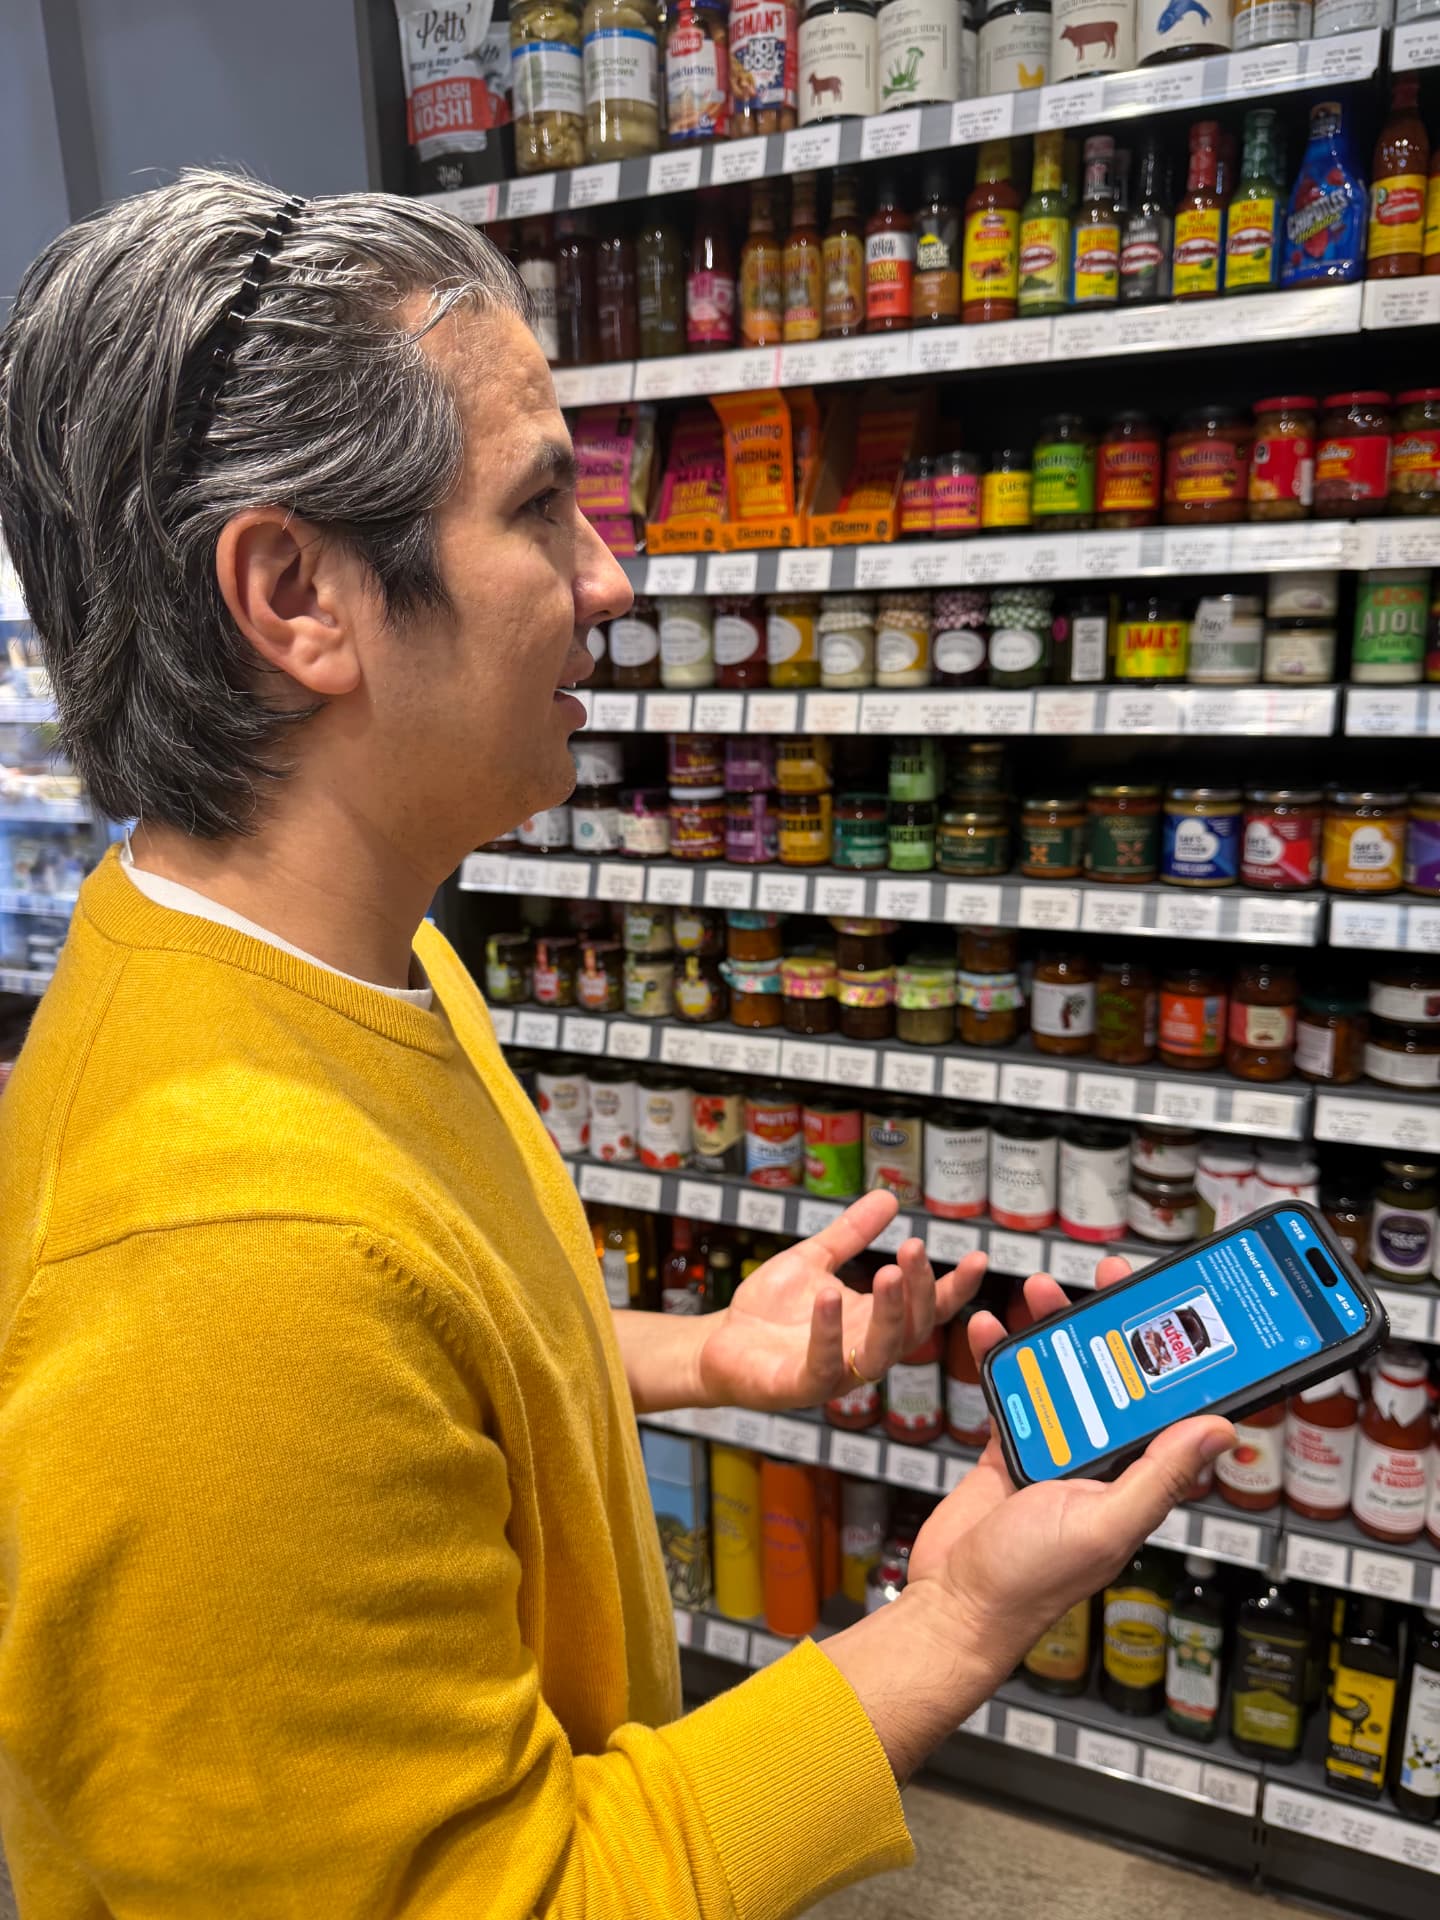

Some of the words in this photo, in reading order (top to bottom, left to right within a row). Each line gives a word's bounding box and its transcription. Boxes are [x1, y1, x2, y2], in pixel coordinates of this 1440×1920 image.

[417, 2, 471, 48] Potts'
[748, 37, 776, 56] HOT
[745, 53, 779, 71] DOG
[438, 81, 471, 100] BASH
[1288, 189, 1349, 241] CHIPOTLES
[1361, 610, 1422, 641] AIOL
[1237, 1236, 1263, 1269] Product
[1256, 1268, 1279, 1298] record
[1282, 1256, 1314, 1299] INVENTORY
[1244, 1293, 1260, 1315] product
[1038, 1403, 1054, 1429] product
